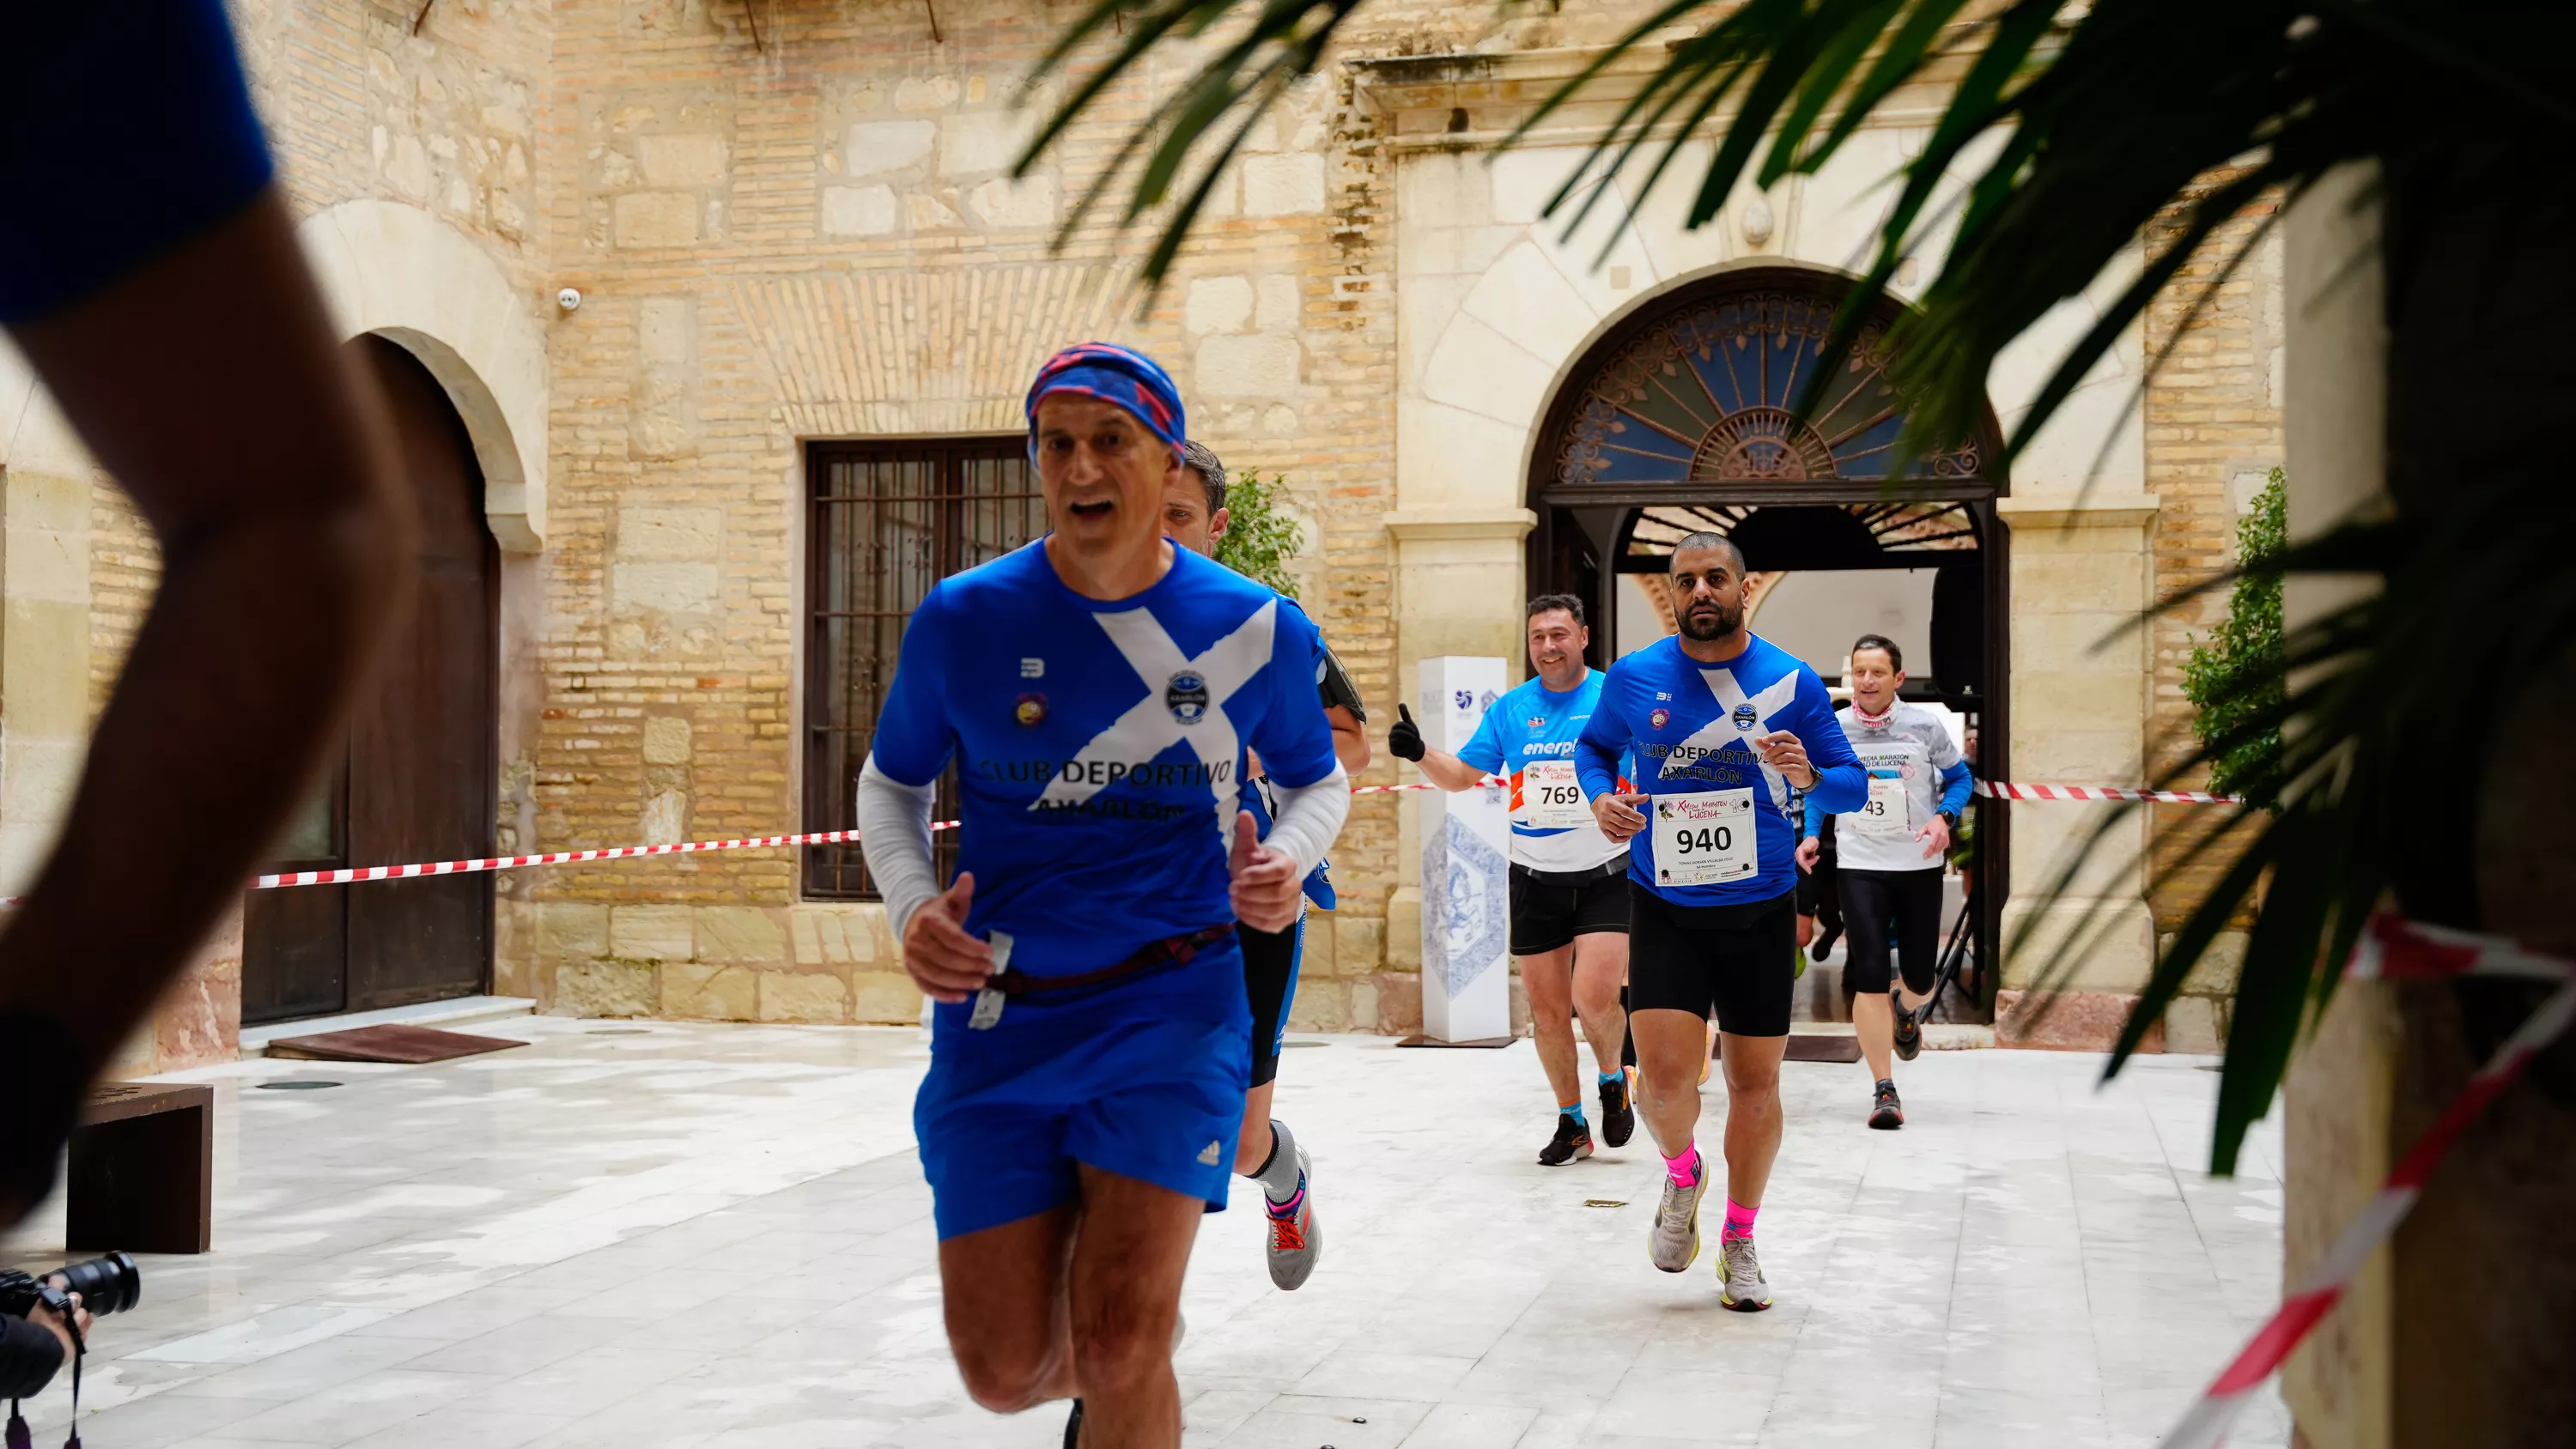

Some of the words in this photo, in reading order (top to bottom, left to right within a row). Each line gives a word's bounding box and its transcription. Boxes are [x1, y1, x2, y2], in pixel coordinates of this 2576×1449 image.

[1673, 745, 1770, 765] DEPORTIV
[1062, 759, 1231, 786] DEPORTIVO
[1662, 766, 1741, 785] AXARLÓN
[1541, 786, 1579, 804] 769
[1688, 809, 1722, 820] LUCENA
[1865, 800, 1885, 815] 43
[1676, 826, 1732, 854] 940
